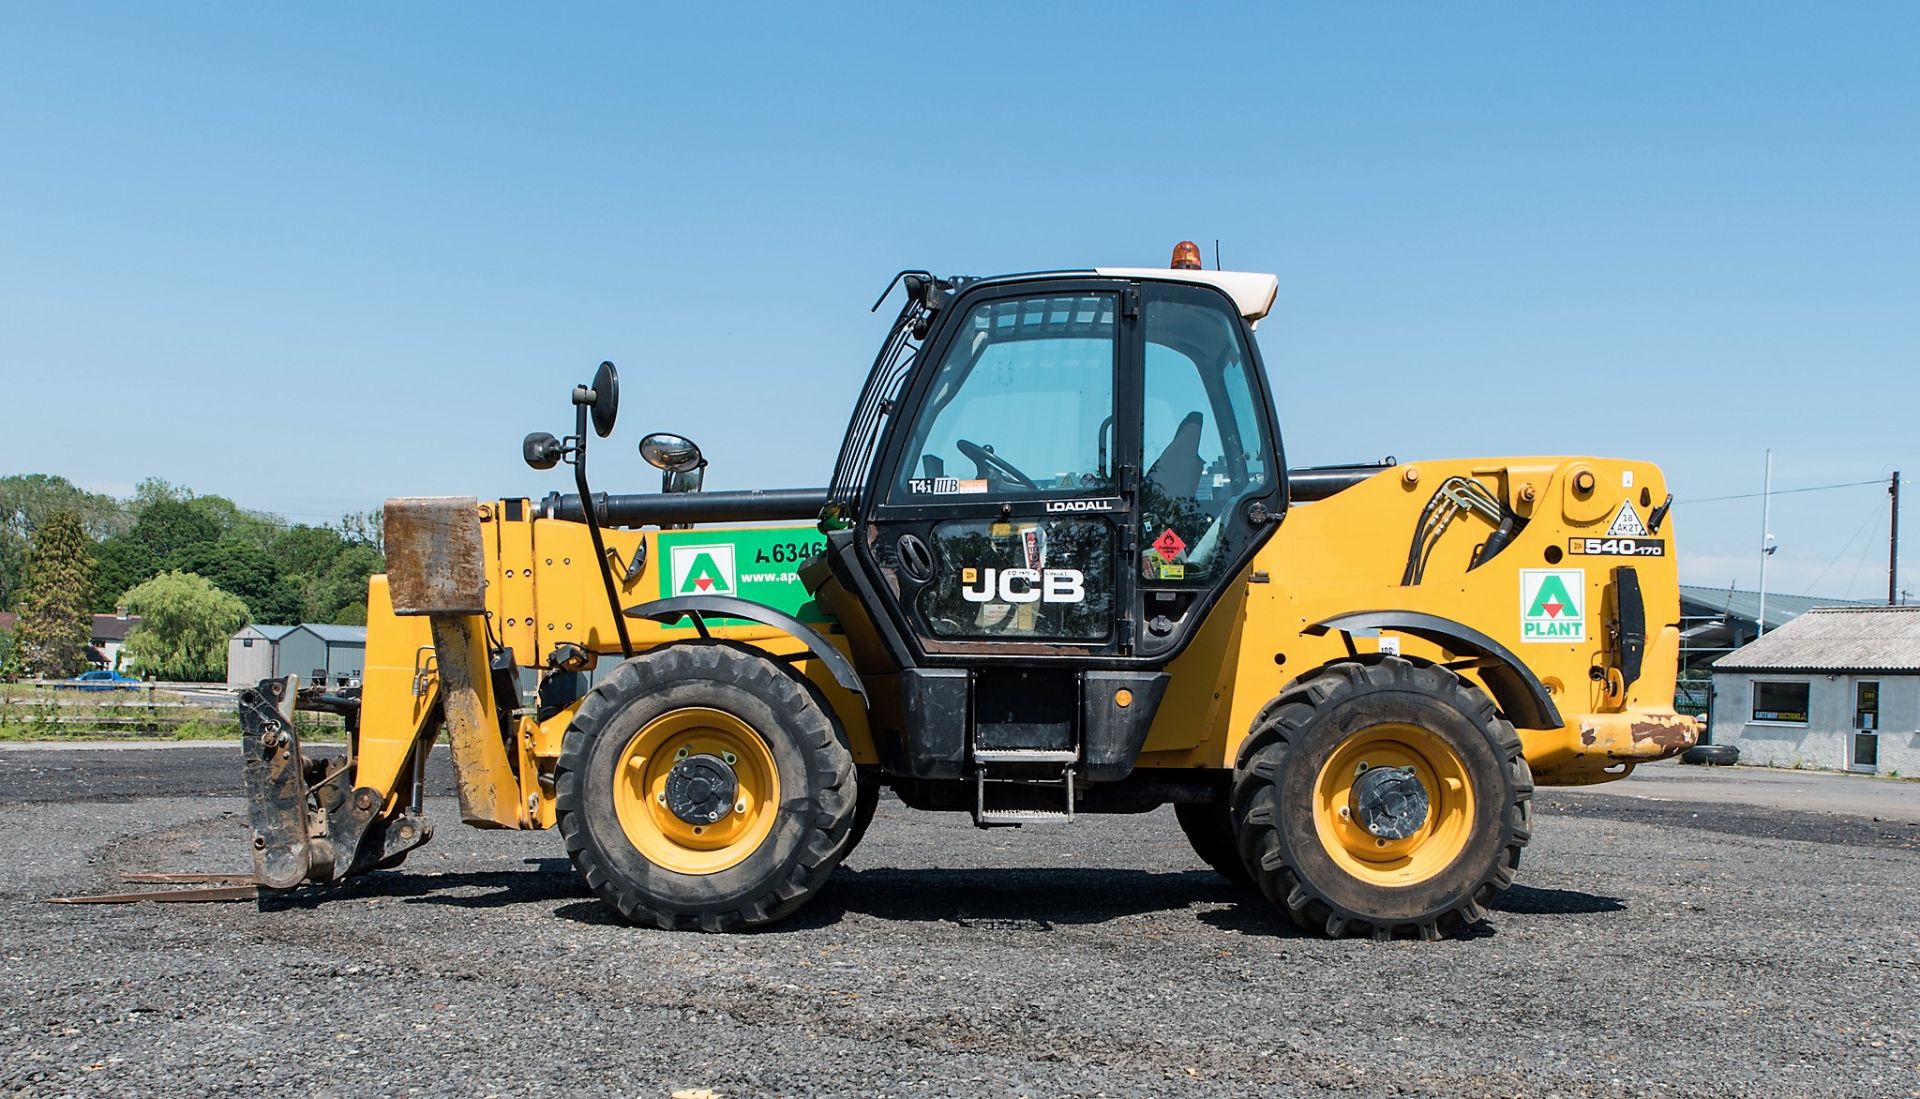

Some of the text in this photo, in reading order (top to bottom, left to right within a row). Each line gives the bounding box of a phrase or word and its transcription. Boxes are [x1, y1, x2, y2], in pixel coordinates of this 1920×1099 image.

[909, 480, 932, 494] T4i
[1046, 501, 1112, 513] LOADALL
[755, 541, 827, 564] A6346
[963, 568, 1085, 602] JCB
[1524, 622, 1583, 636] PLANT
